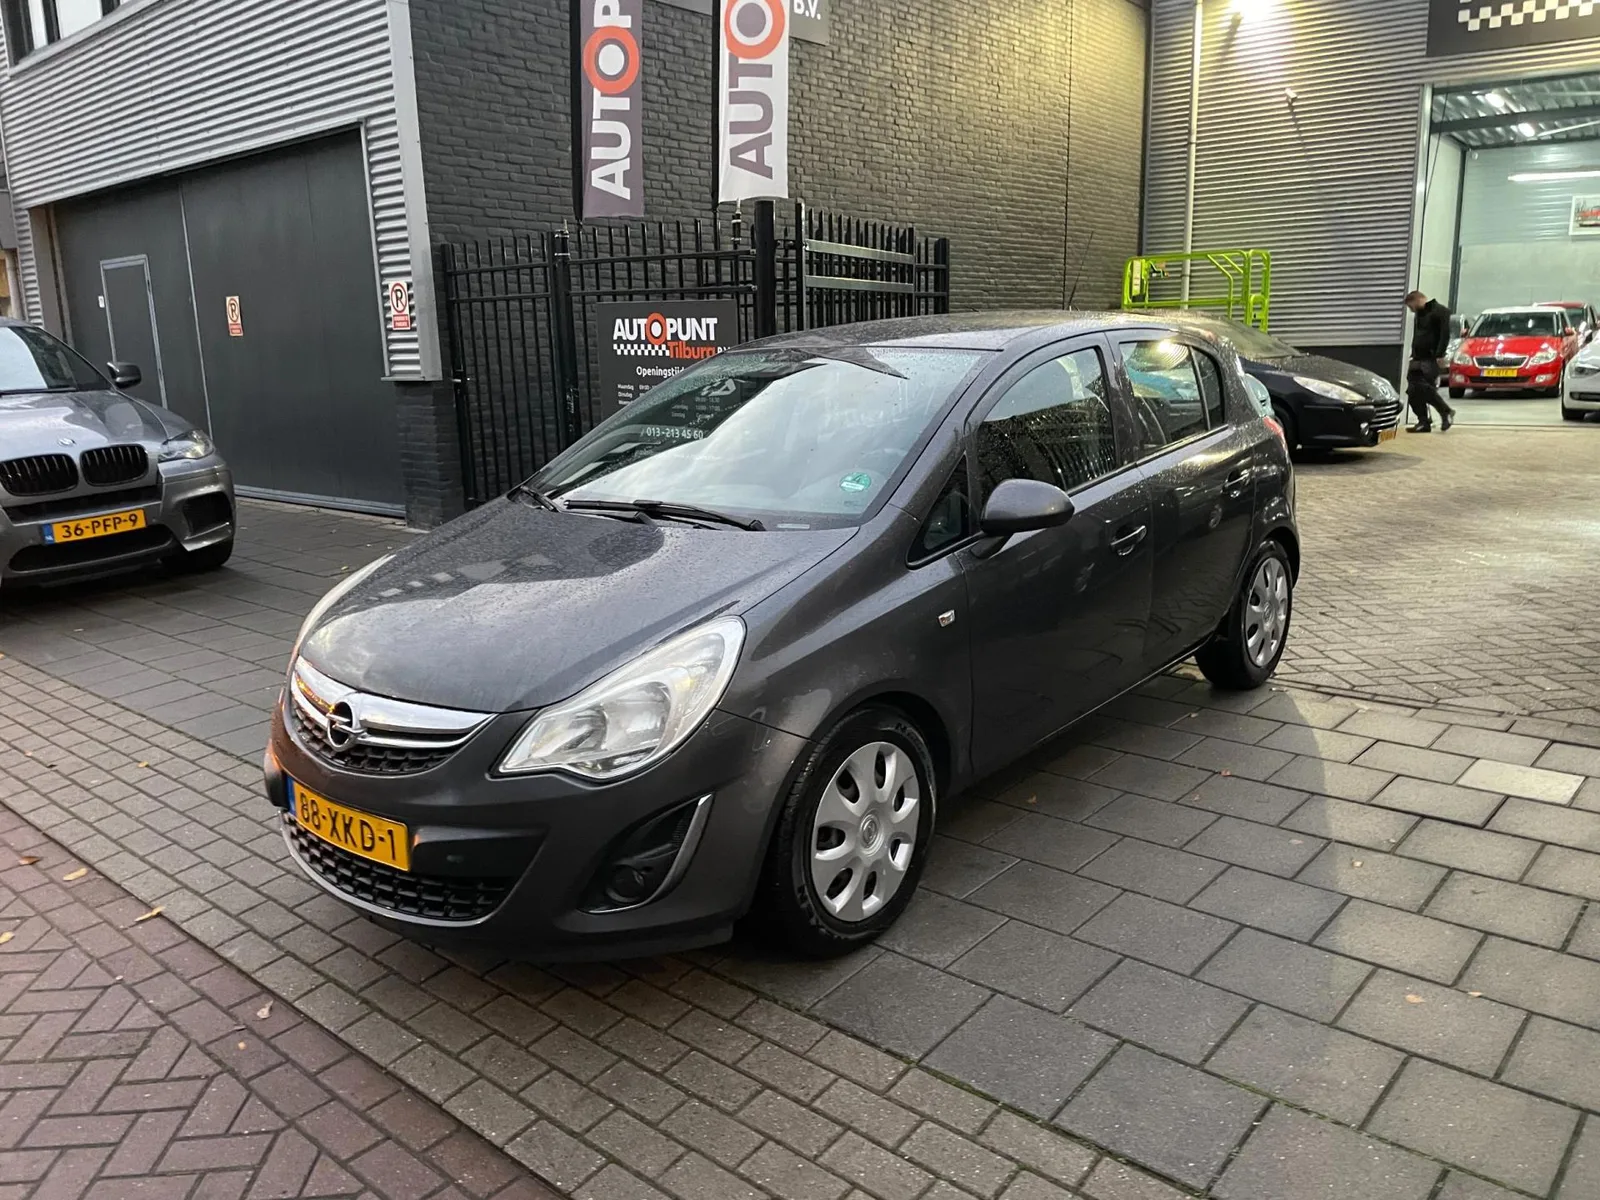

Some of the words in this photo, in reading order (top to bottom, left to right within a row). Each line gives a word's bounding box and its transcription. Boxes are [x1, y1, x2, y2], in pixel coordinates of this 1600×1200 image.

[724, 0, 785, 181] AUTO
[613, 312, 718, 345] AUTOPUNT
[62, 513, 138, 538] 36-PFP-9
[299, 792, 397, 861] 88-XKD-1
